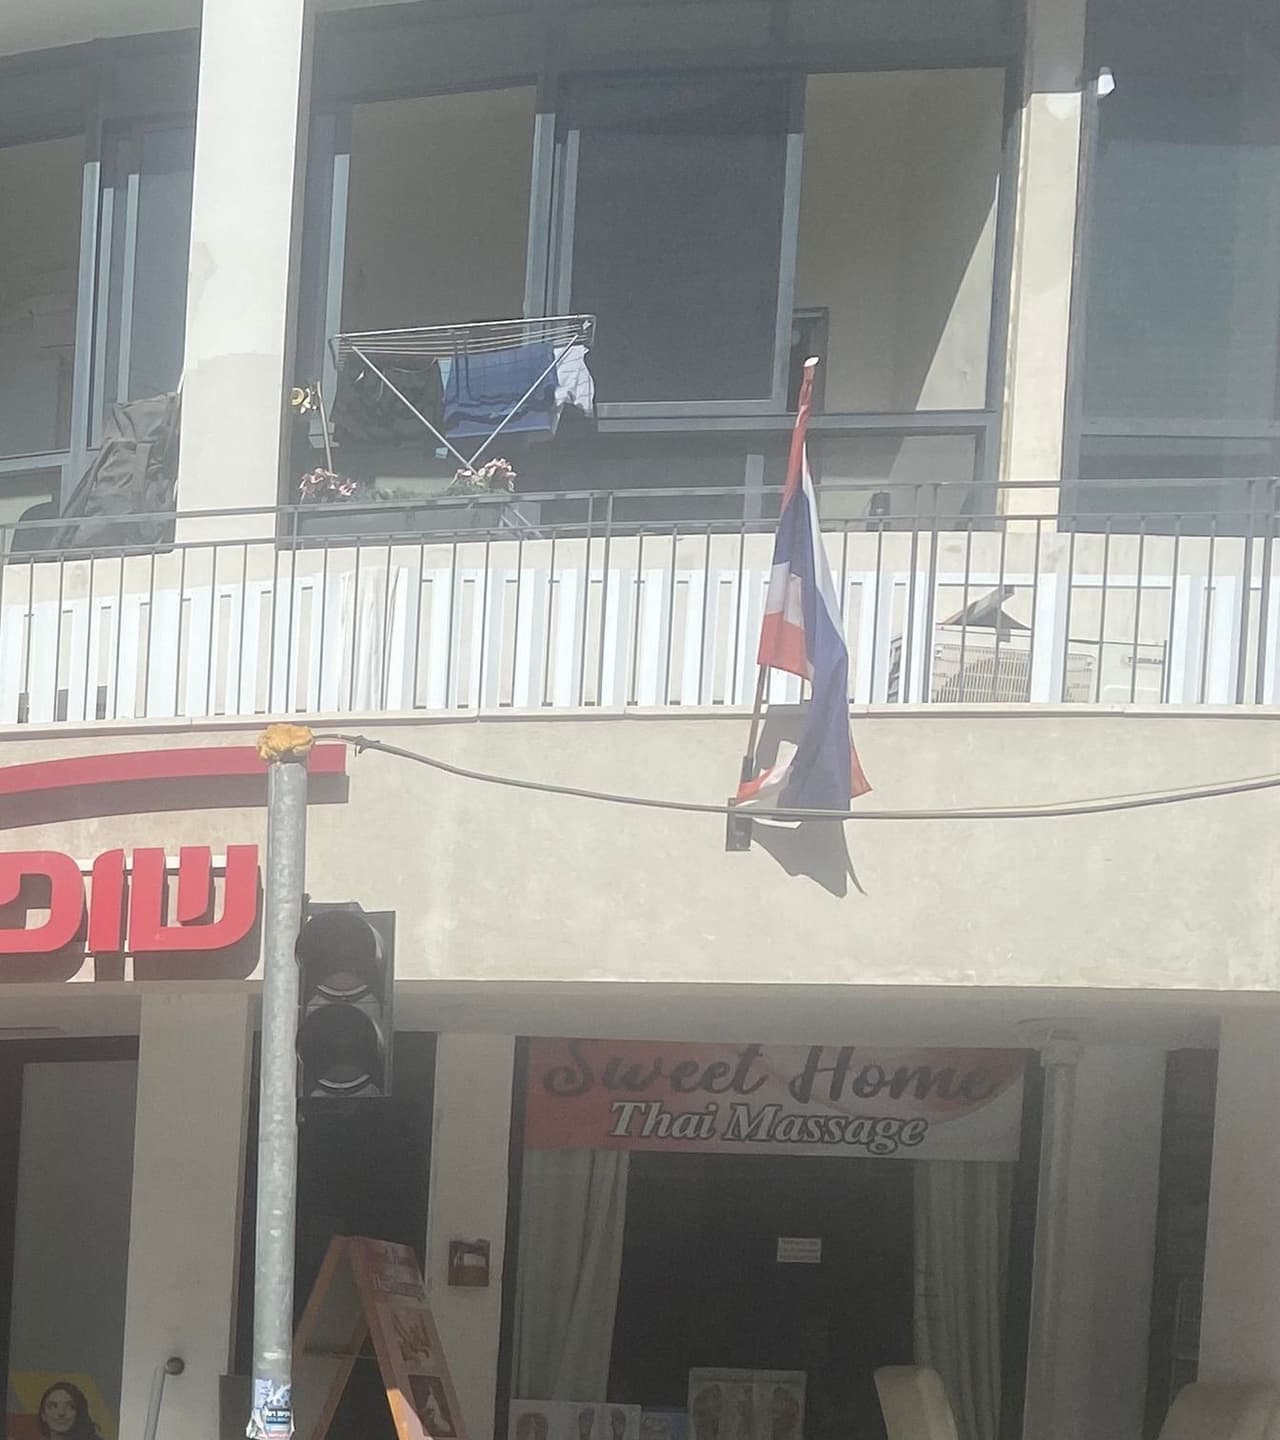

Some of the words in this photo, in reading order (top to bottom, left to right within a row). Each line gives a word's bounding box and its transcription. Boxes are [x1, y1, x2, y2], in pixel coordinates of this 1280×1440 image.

[542, 1043, 768, 1098] Sweet
[788, 1045, 999, 1104] Home
[608, 1100, 718, 1141] Thai
[724, 1103, 929, 1154] Massage
